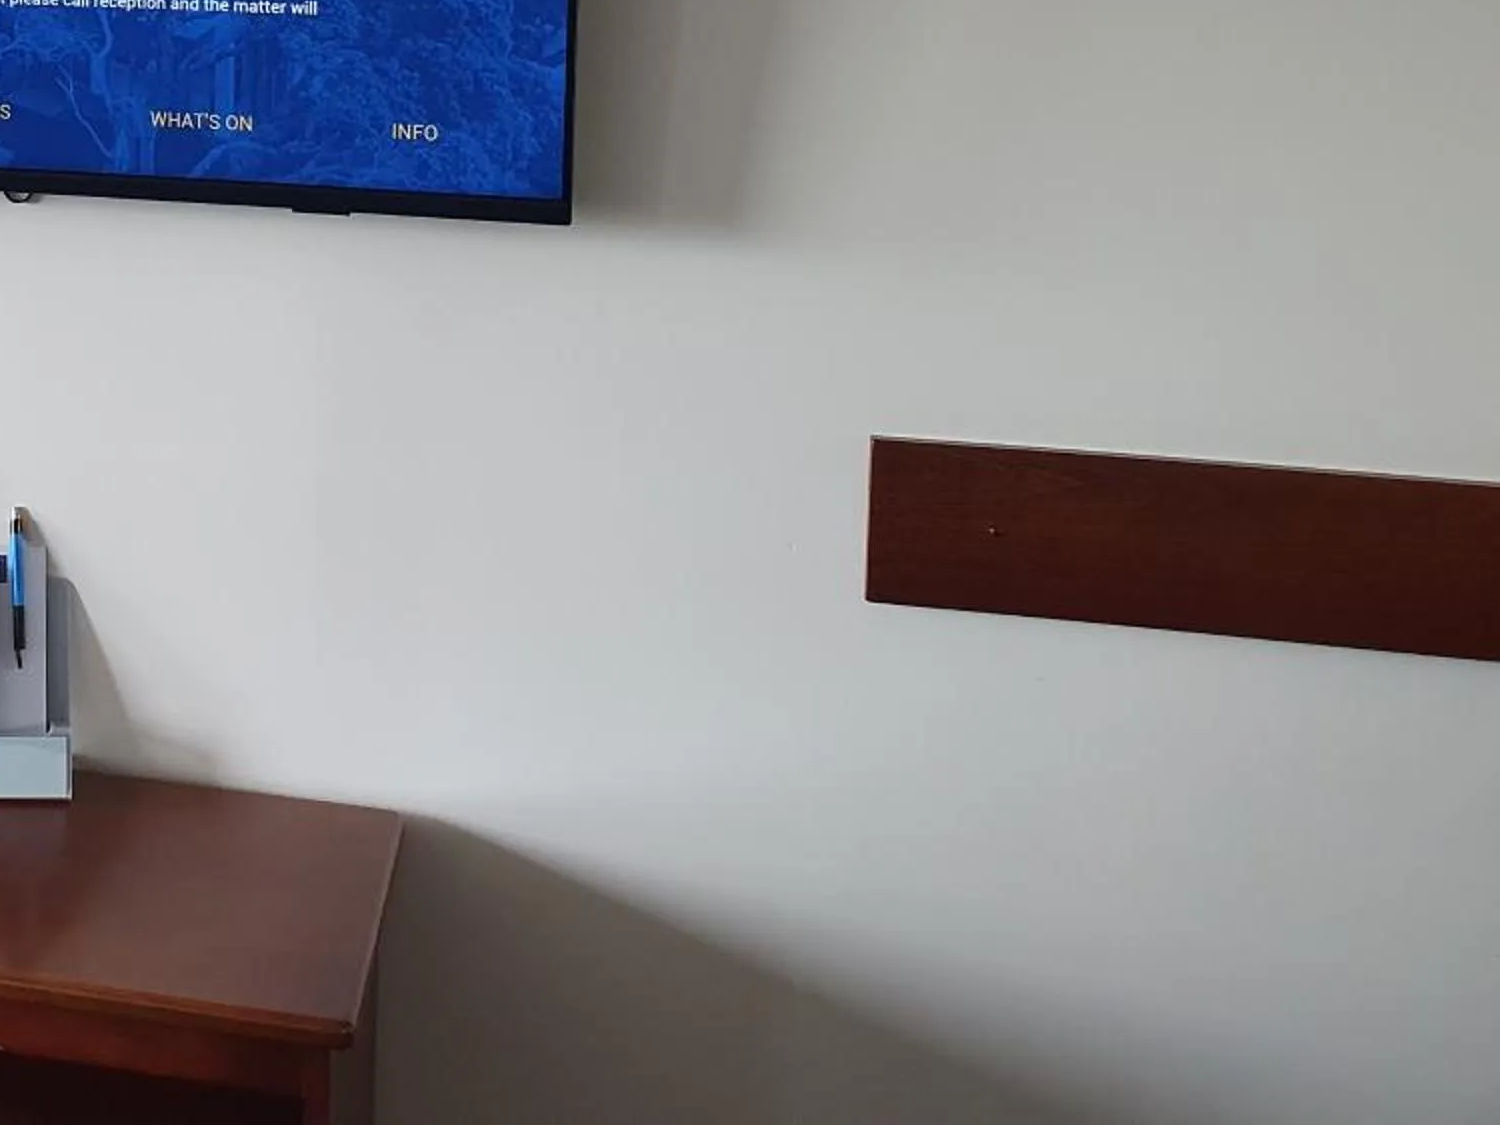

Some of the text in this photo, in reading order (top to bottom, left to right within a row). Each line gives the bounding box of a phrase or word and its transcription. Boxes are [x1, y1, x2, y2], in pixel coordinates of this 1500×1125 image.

[233, 0, 287, 14] matter
[291, 1, 318, 16] will
[150, 110, 254, 132] WHAT'S ON
[392, 122, 439, 142] INFO
